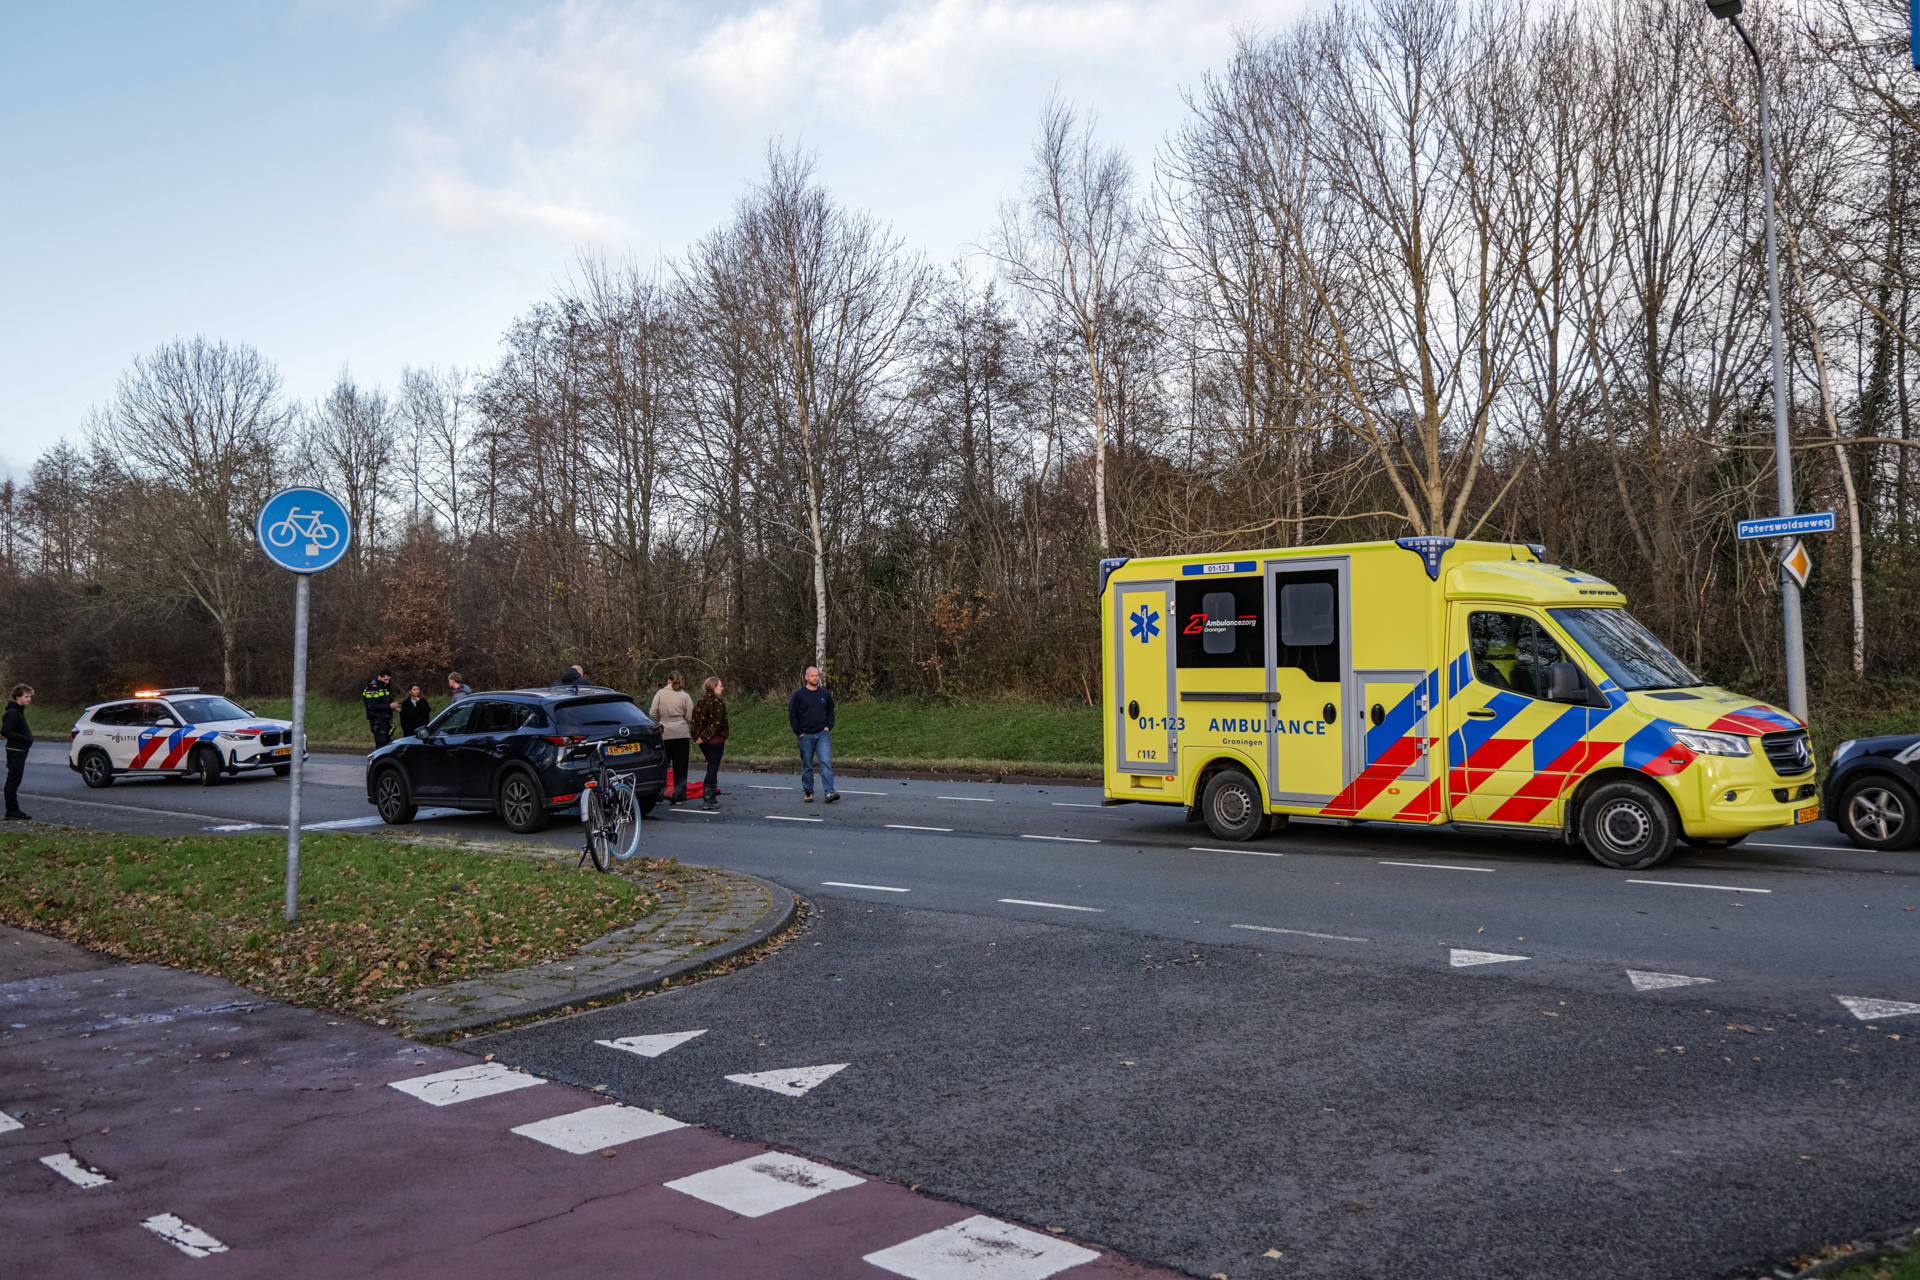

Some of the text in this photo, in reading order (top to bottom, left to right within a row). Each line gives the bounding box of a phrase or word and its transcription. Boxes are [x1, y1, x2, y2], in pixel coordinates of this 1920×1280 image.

[1741, 519, 1831, 534] Paterswoldseweg
[1207, 564, 1230, 572] 01-123
[1205, 619, 1257, 627] Ambulancezorg
[1138, 716, 1186, 731] 01-123
[1208, 718, 1327, 735] AMBULANCE
[111, 735, 137, 743] POLITIE
[1222, 737, 1263, 746] Groningen
[1141, 749, 1157, 760] 112
